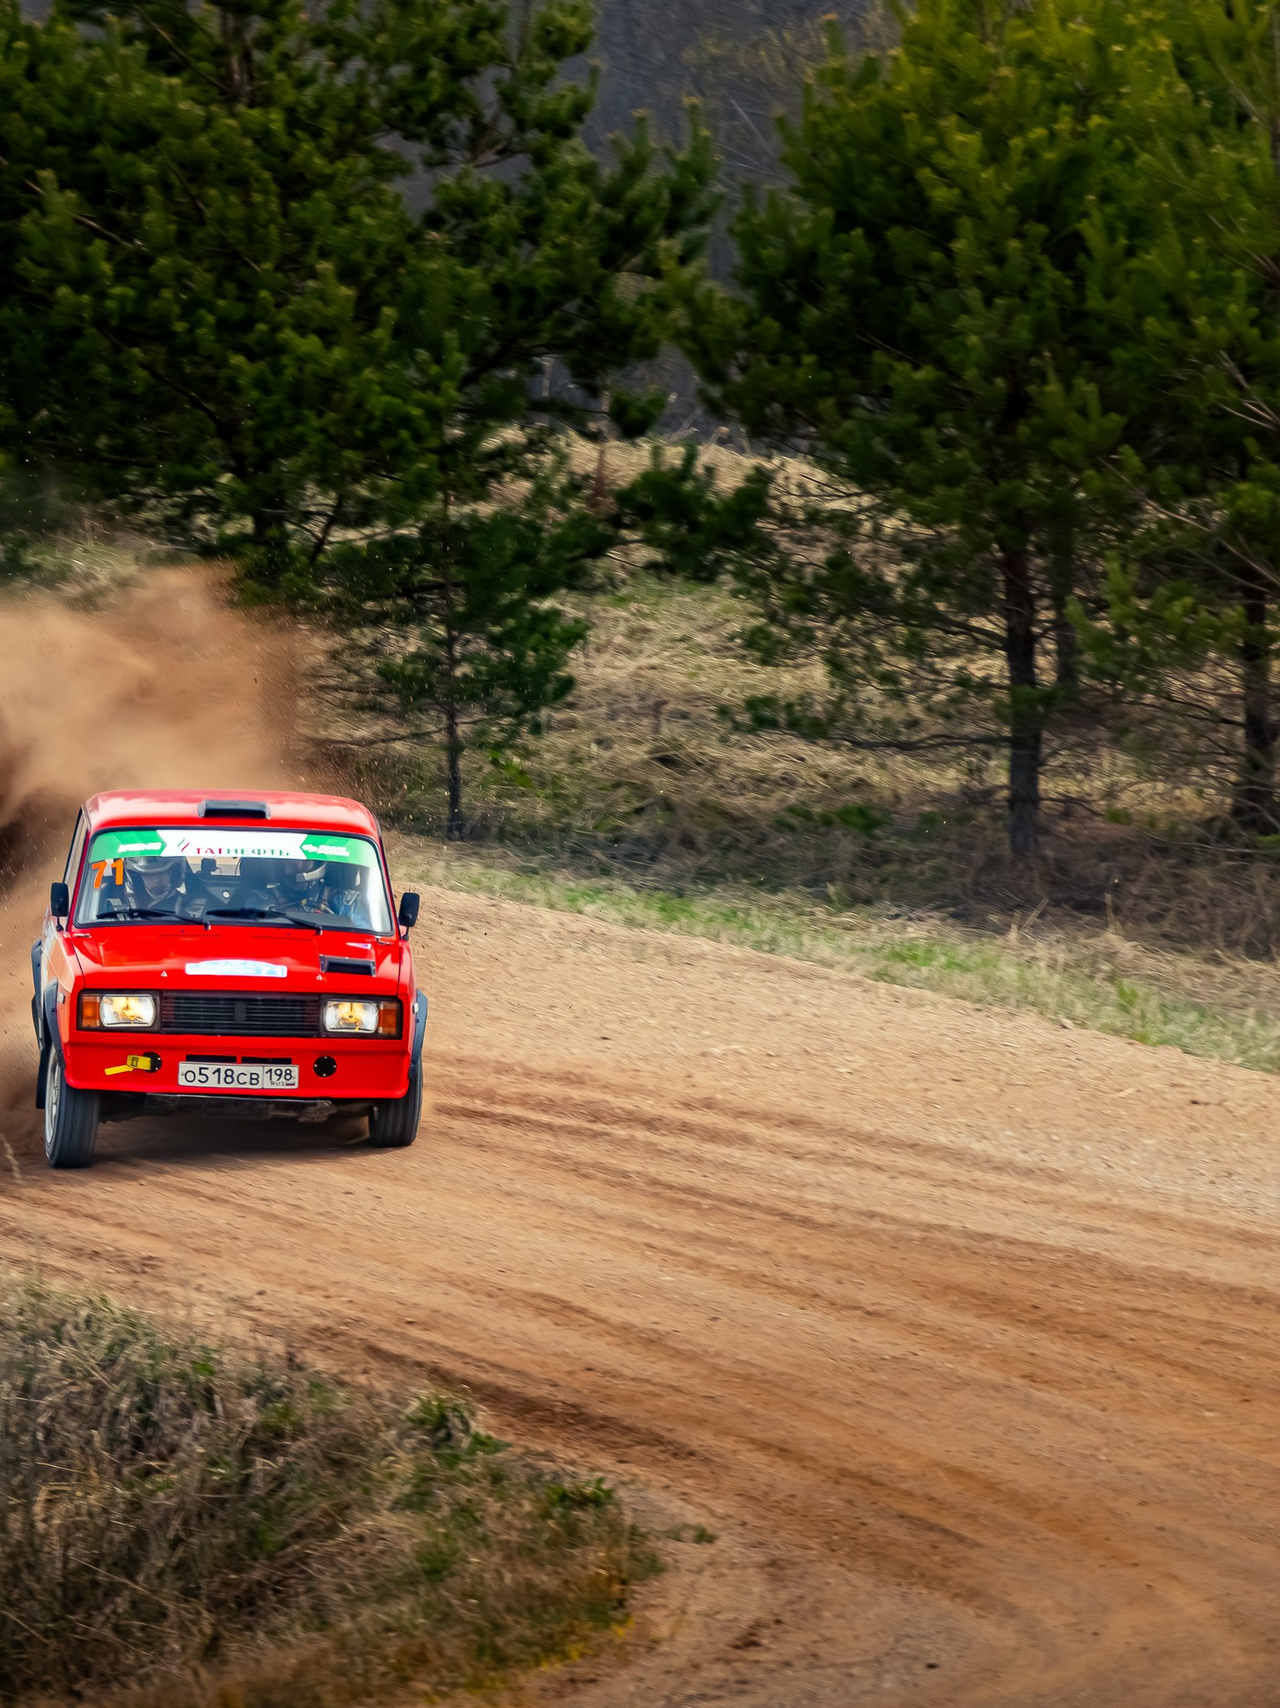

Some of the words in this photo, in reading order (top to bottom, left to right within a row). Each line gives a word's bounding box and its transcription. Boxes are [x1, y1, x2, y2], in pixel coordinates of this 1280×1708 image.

[196, 847, 290, 856] ТАТНЕФТЬ
[92, 858, 124, 889] 71
[265, 1068, 293, 1081] 198
